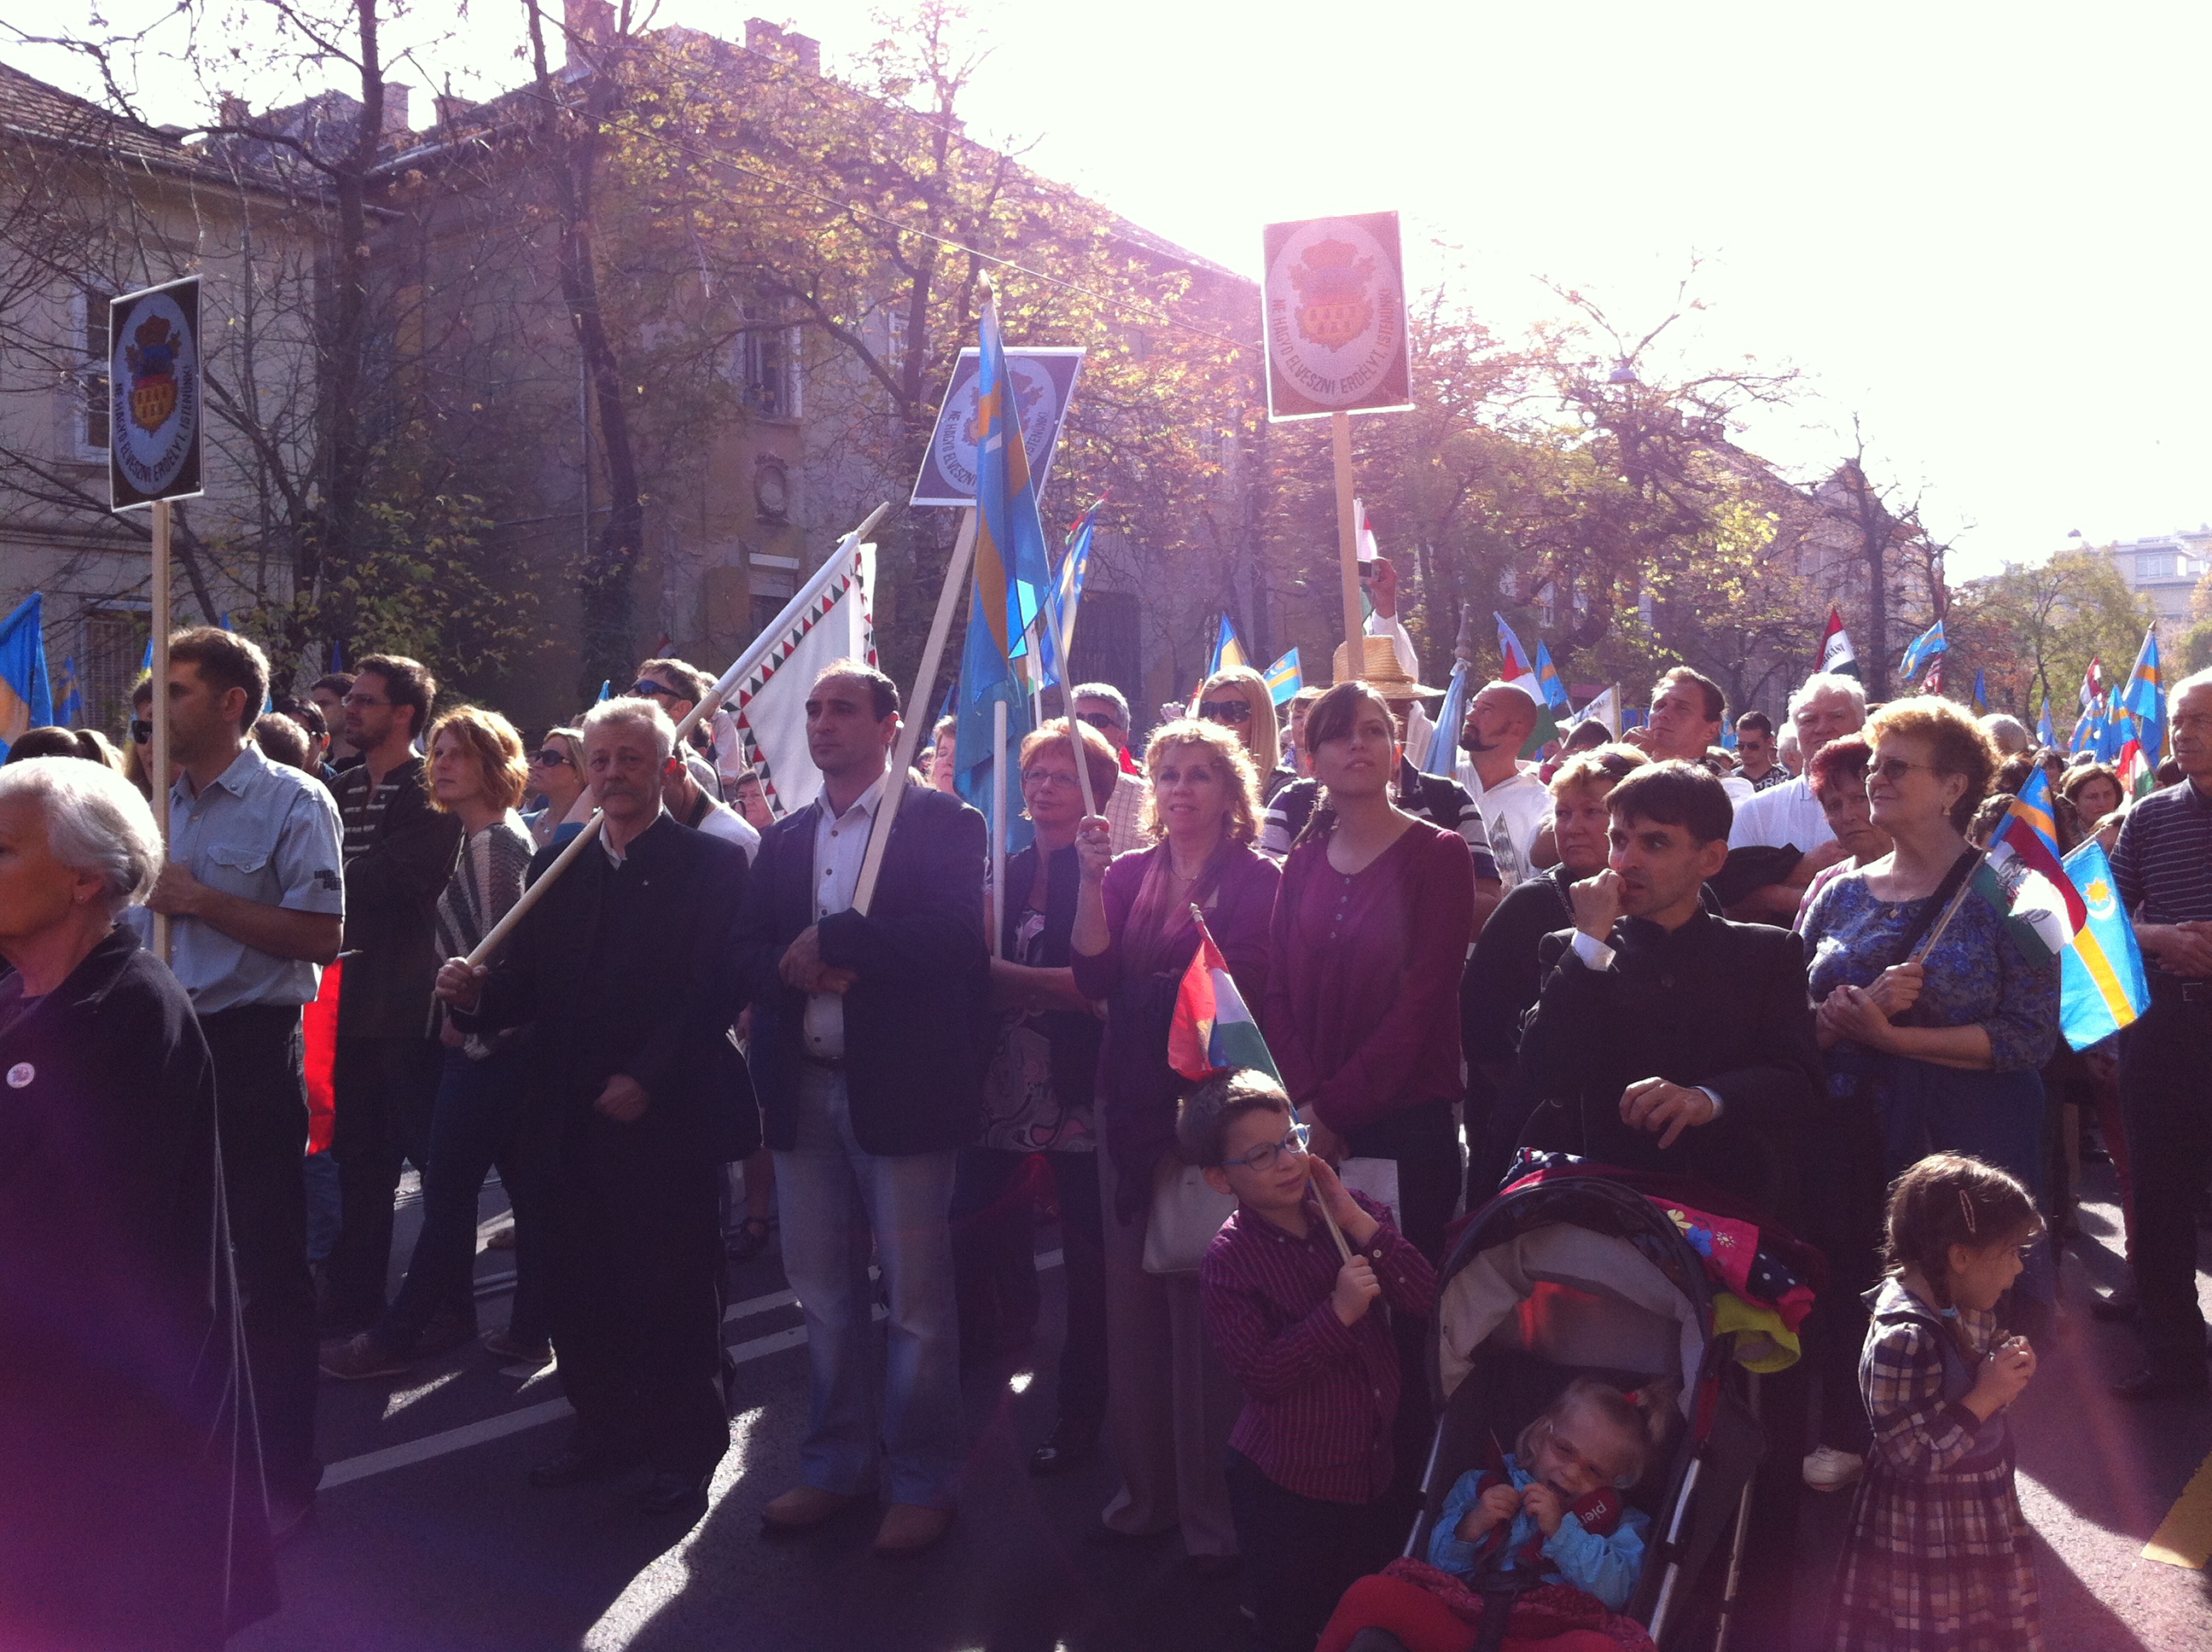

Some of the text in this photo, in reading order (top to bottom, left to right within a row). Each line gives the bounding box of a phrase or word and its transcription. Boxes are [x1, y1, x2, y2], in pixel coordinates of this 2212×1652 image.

[1272, 297, 1286, 313] NE
[1272, 315, 1294, 356] HAGYD
[1284, 353, 1336, 395] ELVESZNI
[947, 410, 962, 422] NE
[941, 423, 958, 452] HAGYD
